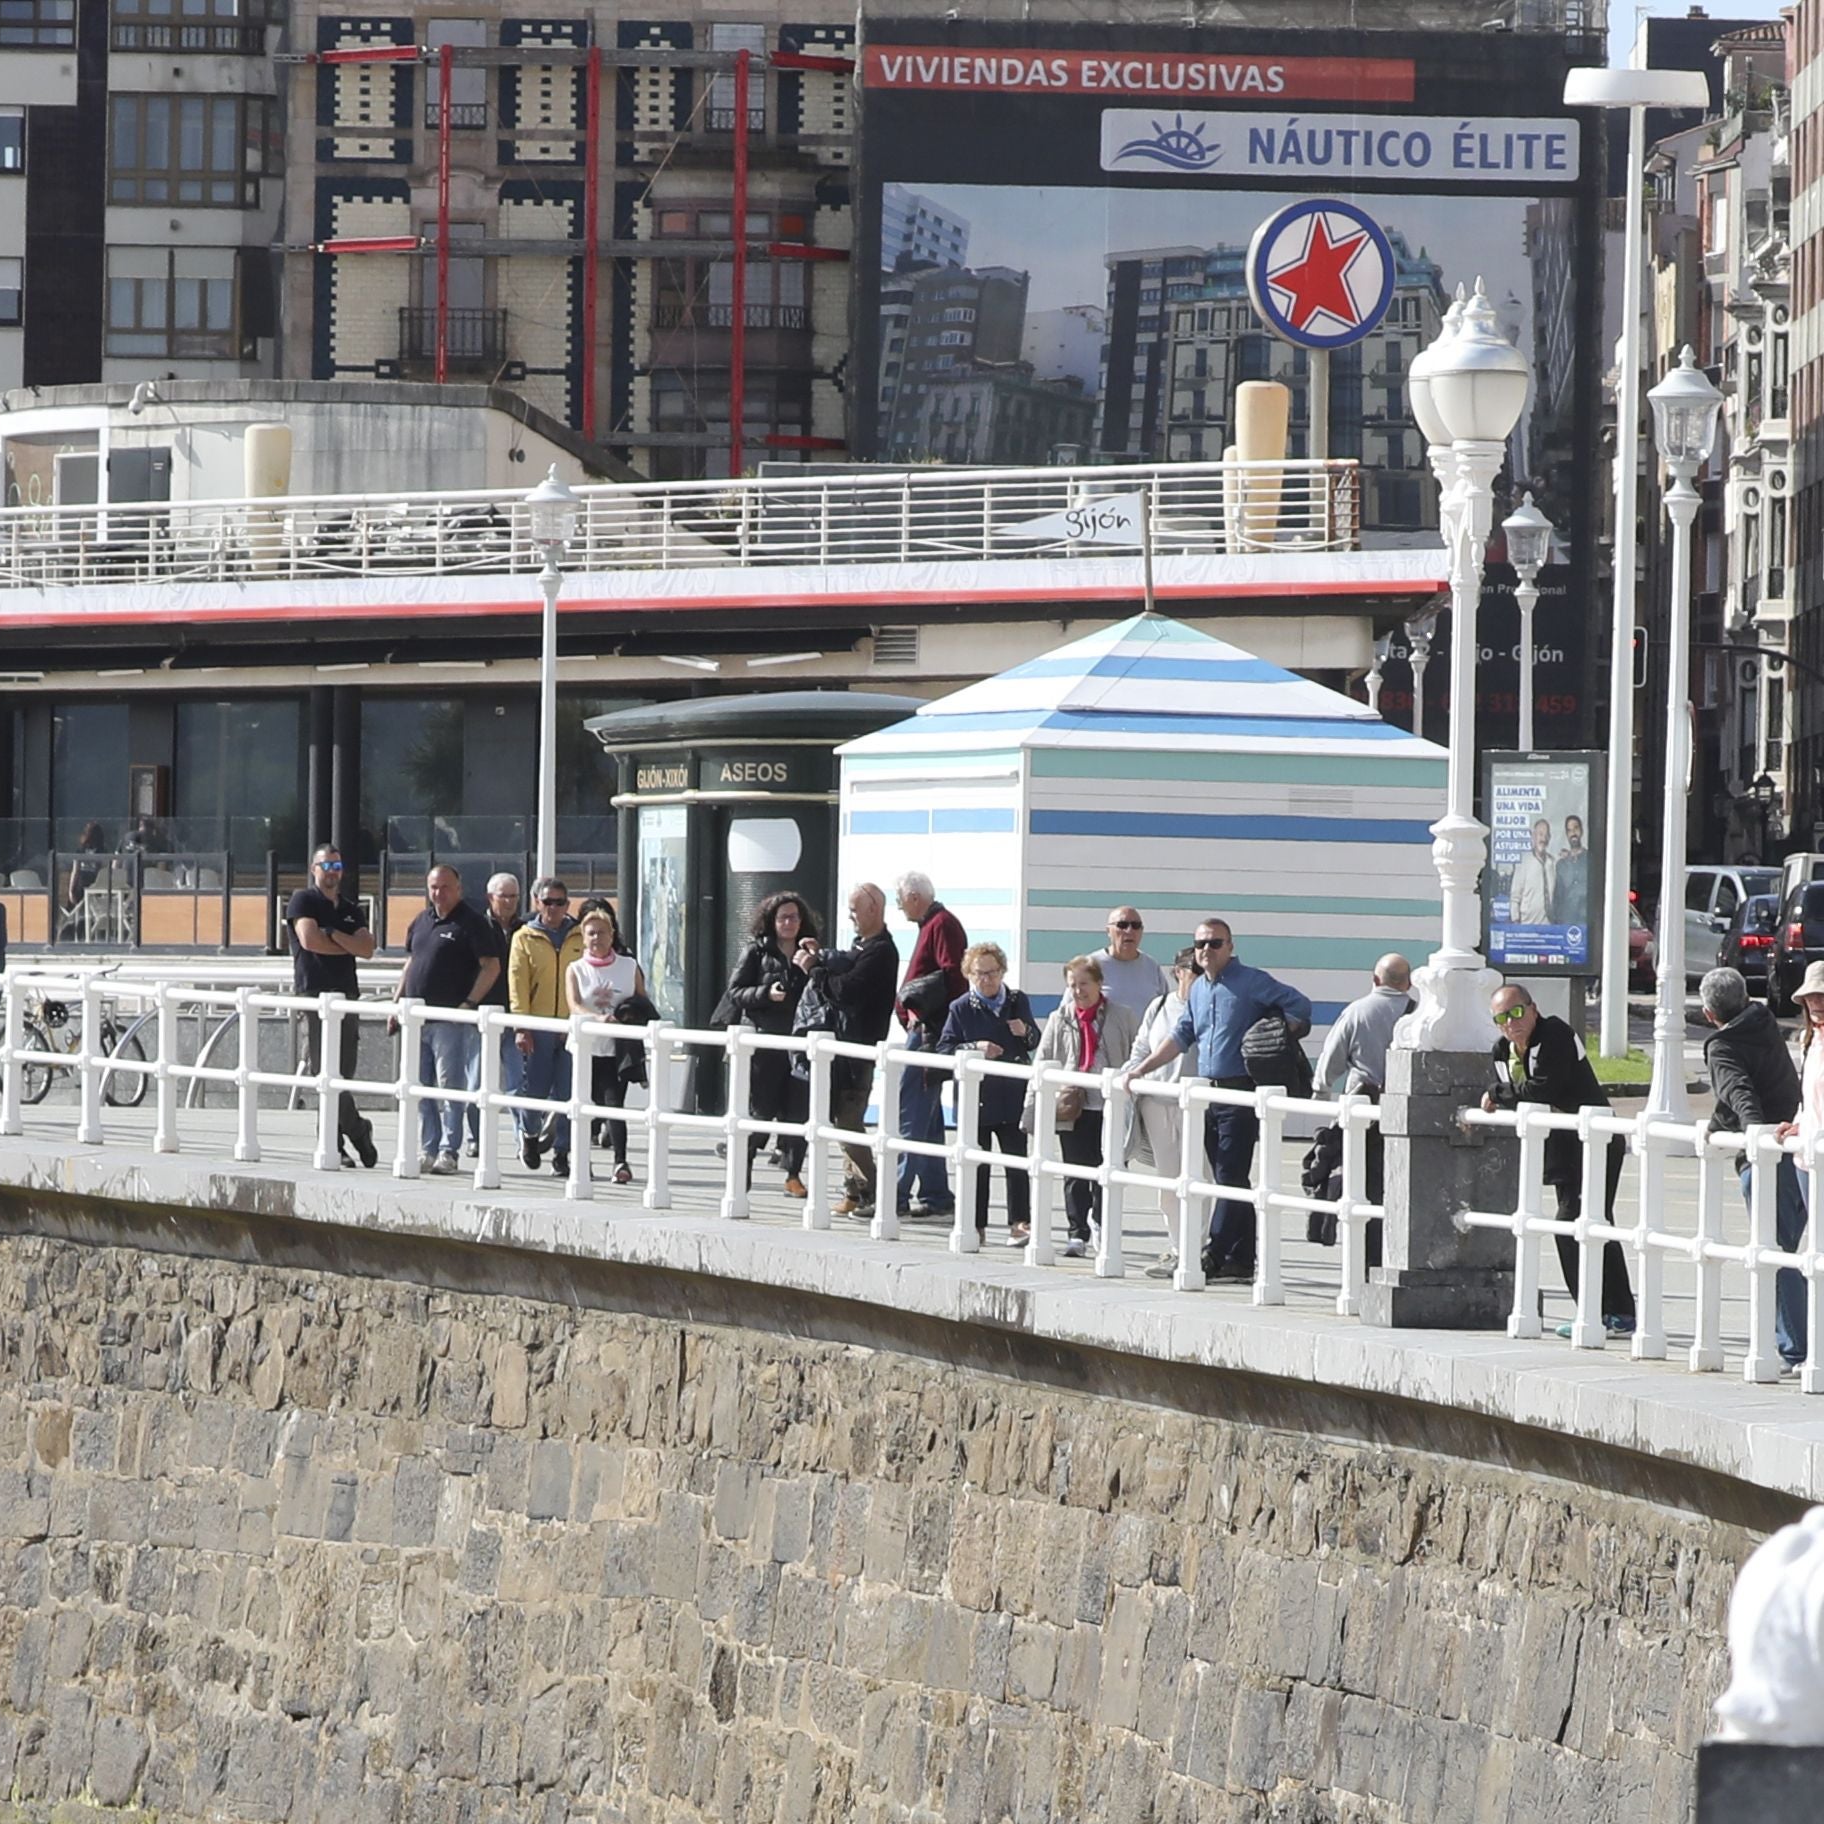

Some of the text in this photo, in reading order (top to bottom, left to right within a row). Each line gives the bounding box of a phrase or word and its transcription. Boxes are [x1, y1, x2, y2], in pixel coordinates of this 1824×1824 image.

[880, 54, 1285, 93] VIVIENDAS EXCLUSIVAS
[1248, 118, 1567, 170] NÁUTICO ÉLITE
[1065, 507, 1131, 539] gijón
[1512, 645, 1564, 666] Gjón
[720, 762, 788, 783] ASEOS
[1496, 788, 1541, 797] ALIMENTA
[1496, 801, 1540, 811] UNA VIDA
[1496, 815, 1526, 825] MEJOR
